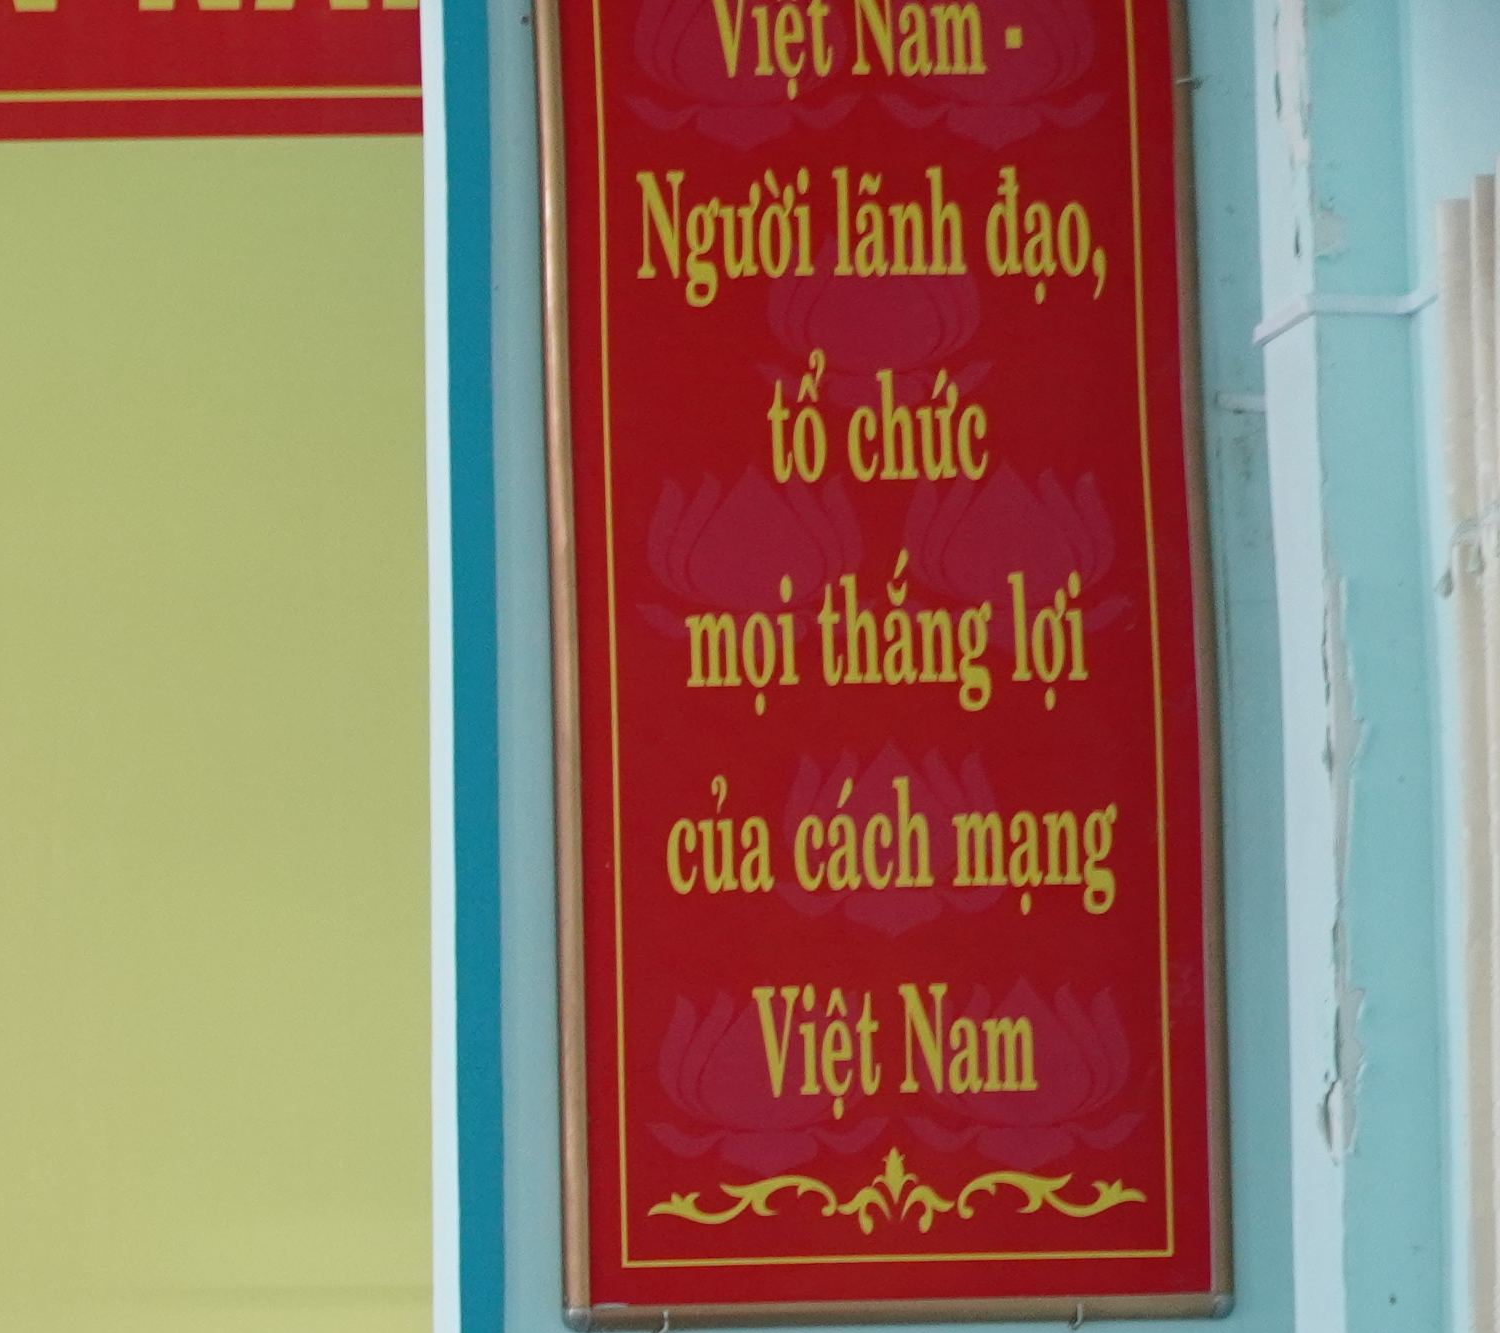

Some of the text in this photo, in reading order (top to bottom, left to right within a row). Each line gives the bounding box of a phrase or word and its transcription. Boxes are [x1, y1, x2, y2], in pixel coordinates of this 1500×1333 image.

[711, 0, 833, 100] Việt
[851, 0, 987, 77] Nam
[636, 166, 1108, 308] Người lãnh đạo,
[767, 348, 988, 484] tổ chức
[684, 548, 1089, 716] mọi thắng lợi
[666, 775, 1118, 916] của cách mạng
[751, 982, 1039, 1120] Việt Nam
